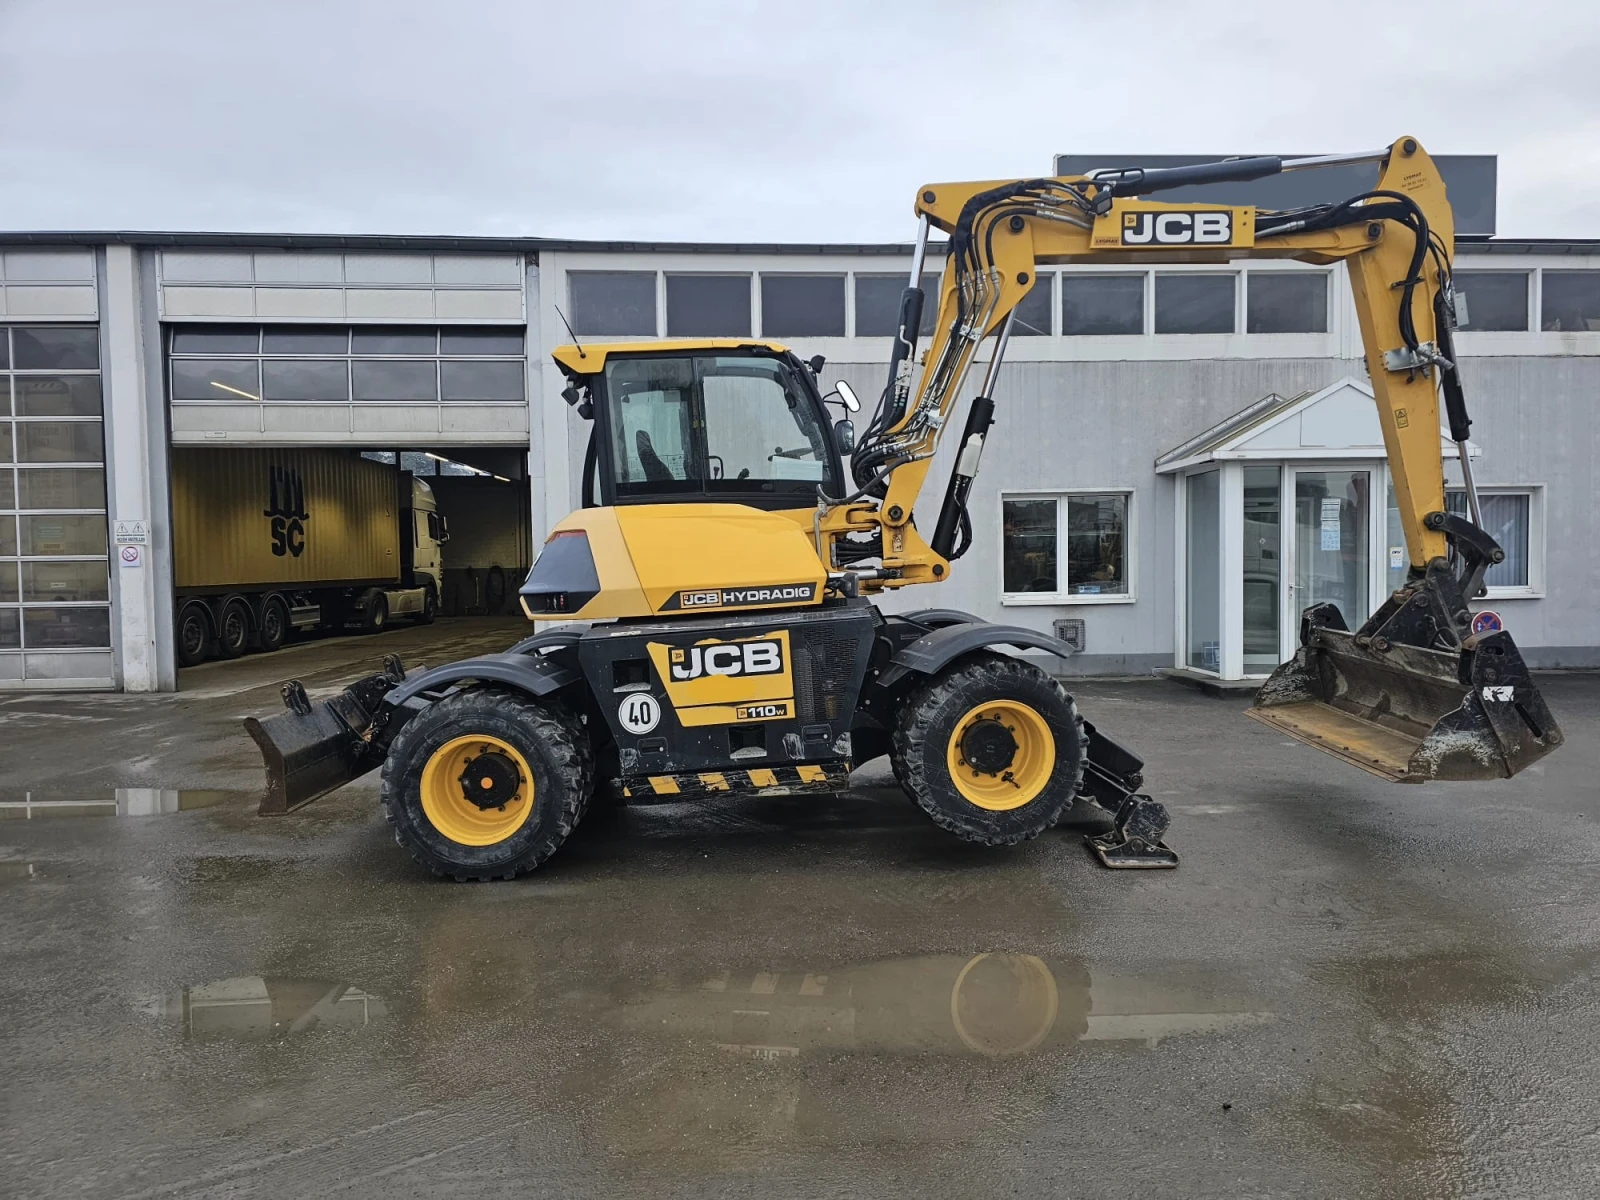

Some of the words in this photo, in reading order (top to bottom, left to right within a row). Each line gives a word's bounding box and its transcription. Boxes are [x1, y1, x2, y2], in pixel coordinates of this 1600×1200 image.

[1124, 213, 1230, 243] JCB
[684, 593, 719, 605] JCB
[723, 587, 810, 602] HYDRADIG
[672, 642, 781, 679] JCB
[628, 701, 651, 726] 40
